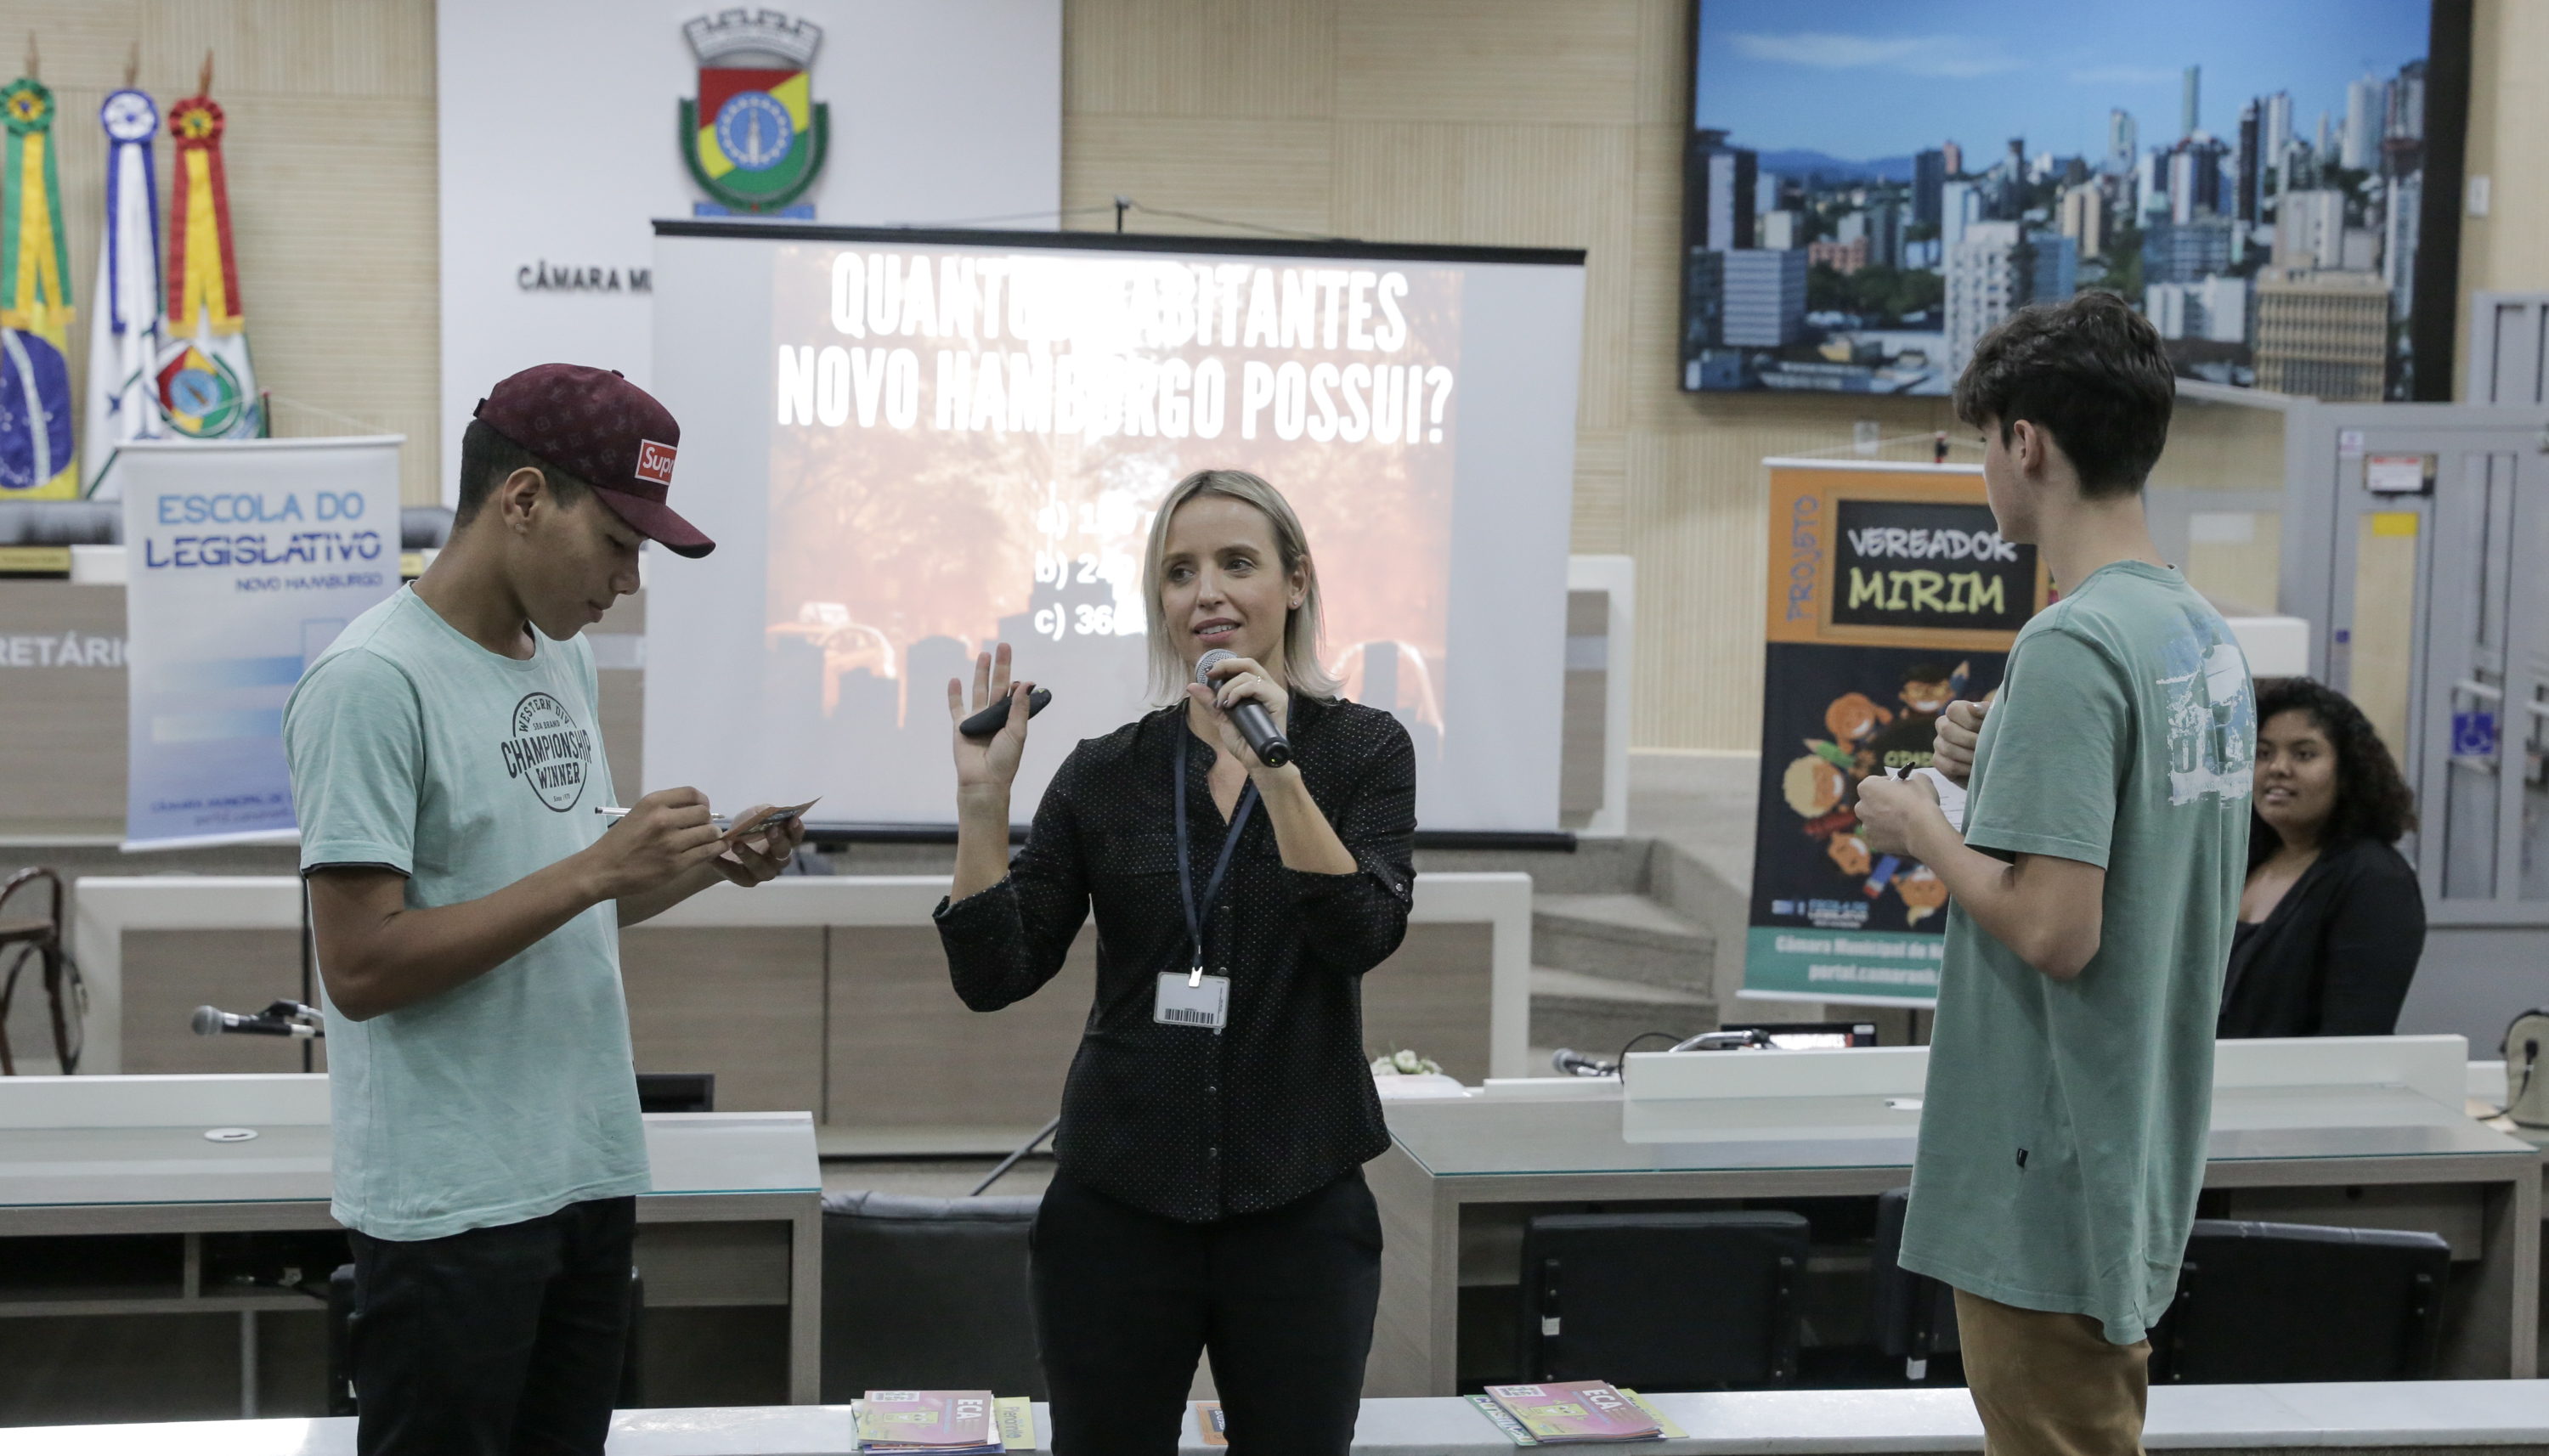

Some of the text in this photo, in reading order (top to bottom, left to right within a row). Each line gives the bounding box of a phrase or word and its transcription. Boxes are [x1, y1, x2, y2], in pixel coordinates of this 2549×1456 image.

[517, 257, 621, 291] CÂMARA
[1091, 260, 1408, 353] ABITANTES
[777, 344, 1454, 444] NOVO HAMBURGO POSSUI?
[158, 491, 365, 525] ESCOLA DO
[145, 529, 382, 568] LEGISLATIVO
[1786, 494, 1823, 623] PROJETO
[1847, 526, 2019, 563] VEREADOR
[235, 572, 383, 592] NOVO HAMBURGO
[1035, 550, 1070, 590] b)
[1848, 567, 2005, 615] MIRIM
[1034, 601, 1066, 642] c)
[0, 629, 128, 668] ETÁRI
[518, 697, 552, 733] WESTERN
[543, 720, 561, 730] BRAND
[500, 729, 592, 779] CHAMPIONSHIP
[535, 762, 580, 790] WINNER
[957, 1398, 983, 1420] ECA
[1582, 1389, 1623, 1409] ECA
